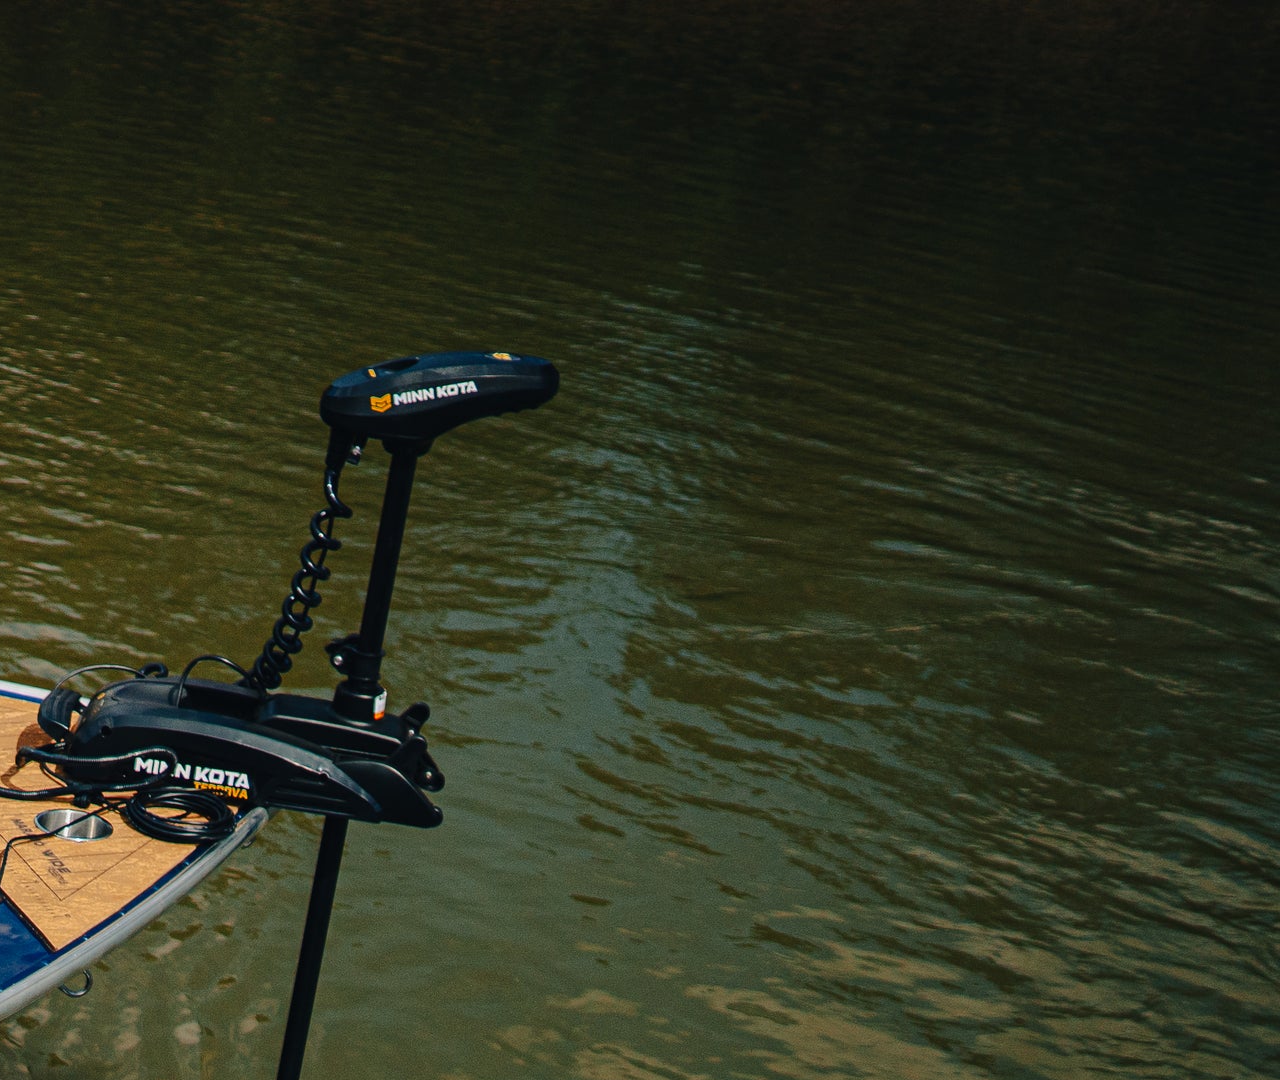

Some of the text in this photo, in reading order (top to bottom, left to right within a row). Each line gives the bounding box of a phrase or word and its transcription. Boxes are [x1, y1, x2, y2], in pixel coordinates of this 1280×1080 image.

[393, 380, 478, 406] MINN KOTA
[194, 766, 250, 790] KOTA
[42, 848, 72, 874] WIDE
